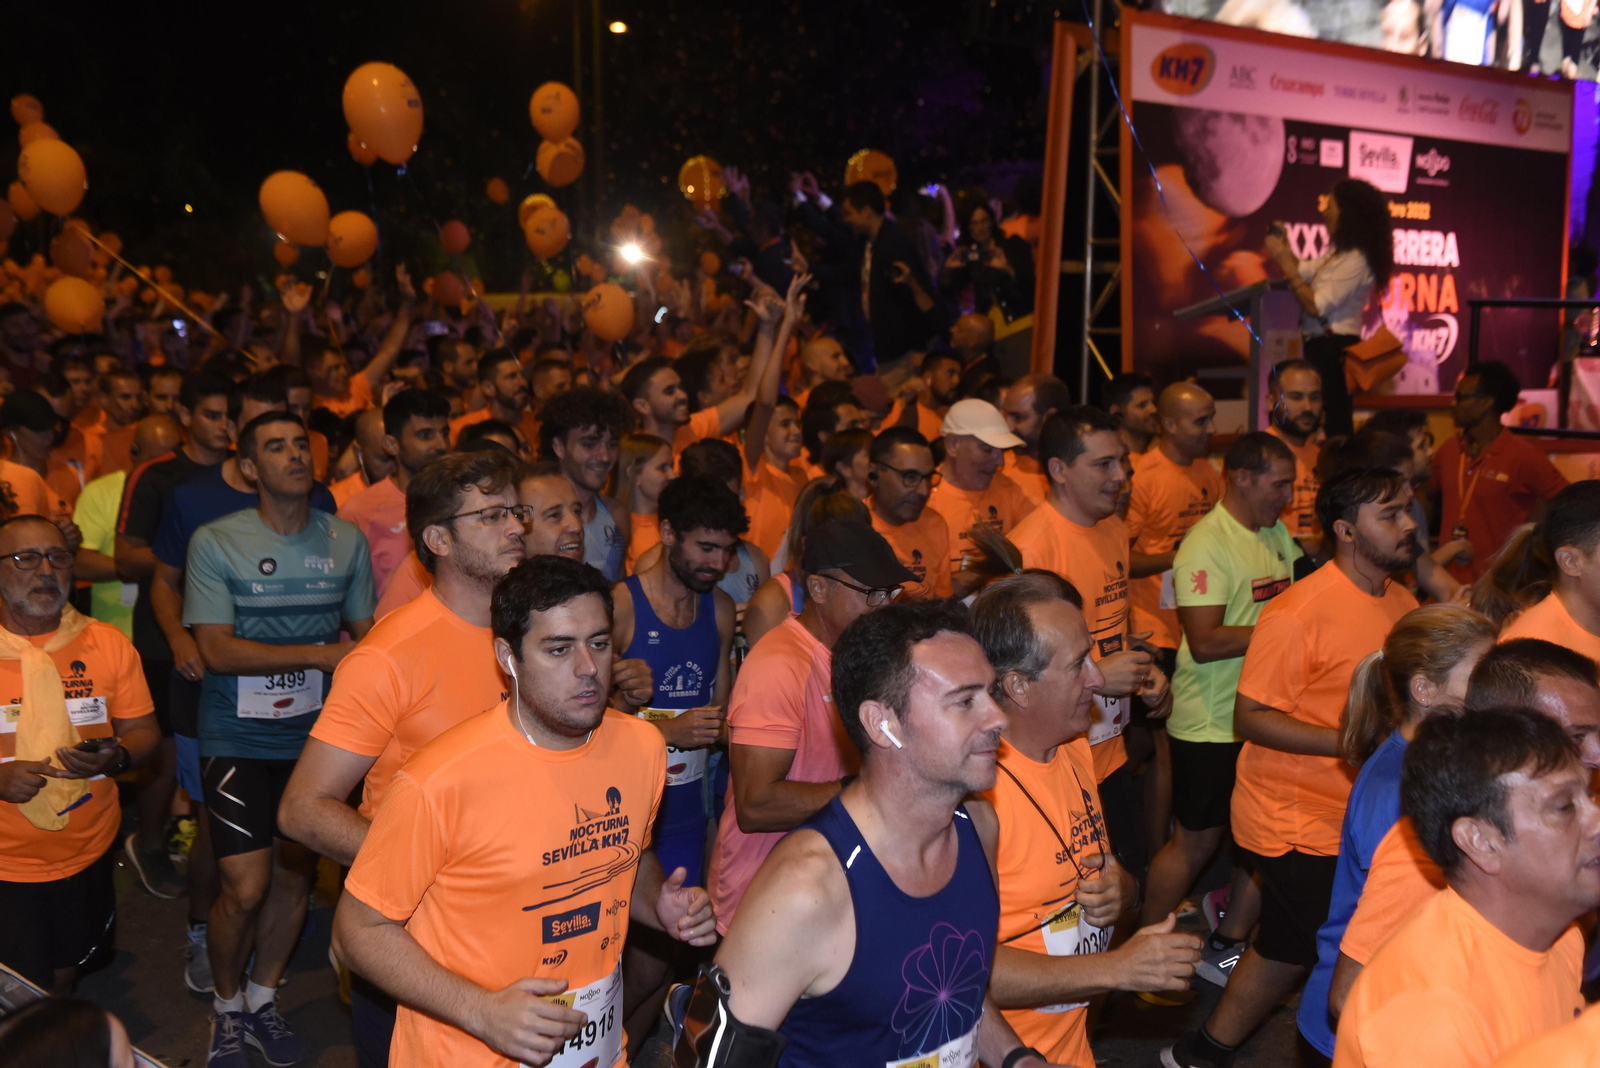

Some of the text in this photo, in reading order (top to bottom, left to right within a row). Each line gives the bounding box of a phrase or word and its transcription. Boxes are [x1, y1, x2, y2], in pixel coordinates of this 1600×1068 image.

[1159, 55, 1205, 86] KH7
[1393, 228, 1460, 268] RRERA
[1411, 326, 1450, 356] KH7
[62, 679, 93, 689] TURNA
[65, 688, 93, 699] KH7
[265, 671, 305, 690] 3499
[569, 815, 629, 841] NOCTURNA
[542, 828, 629, 866] SEVILLA KH7
[542, 953, 563, 966] KH7
